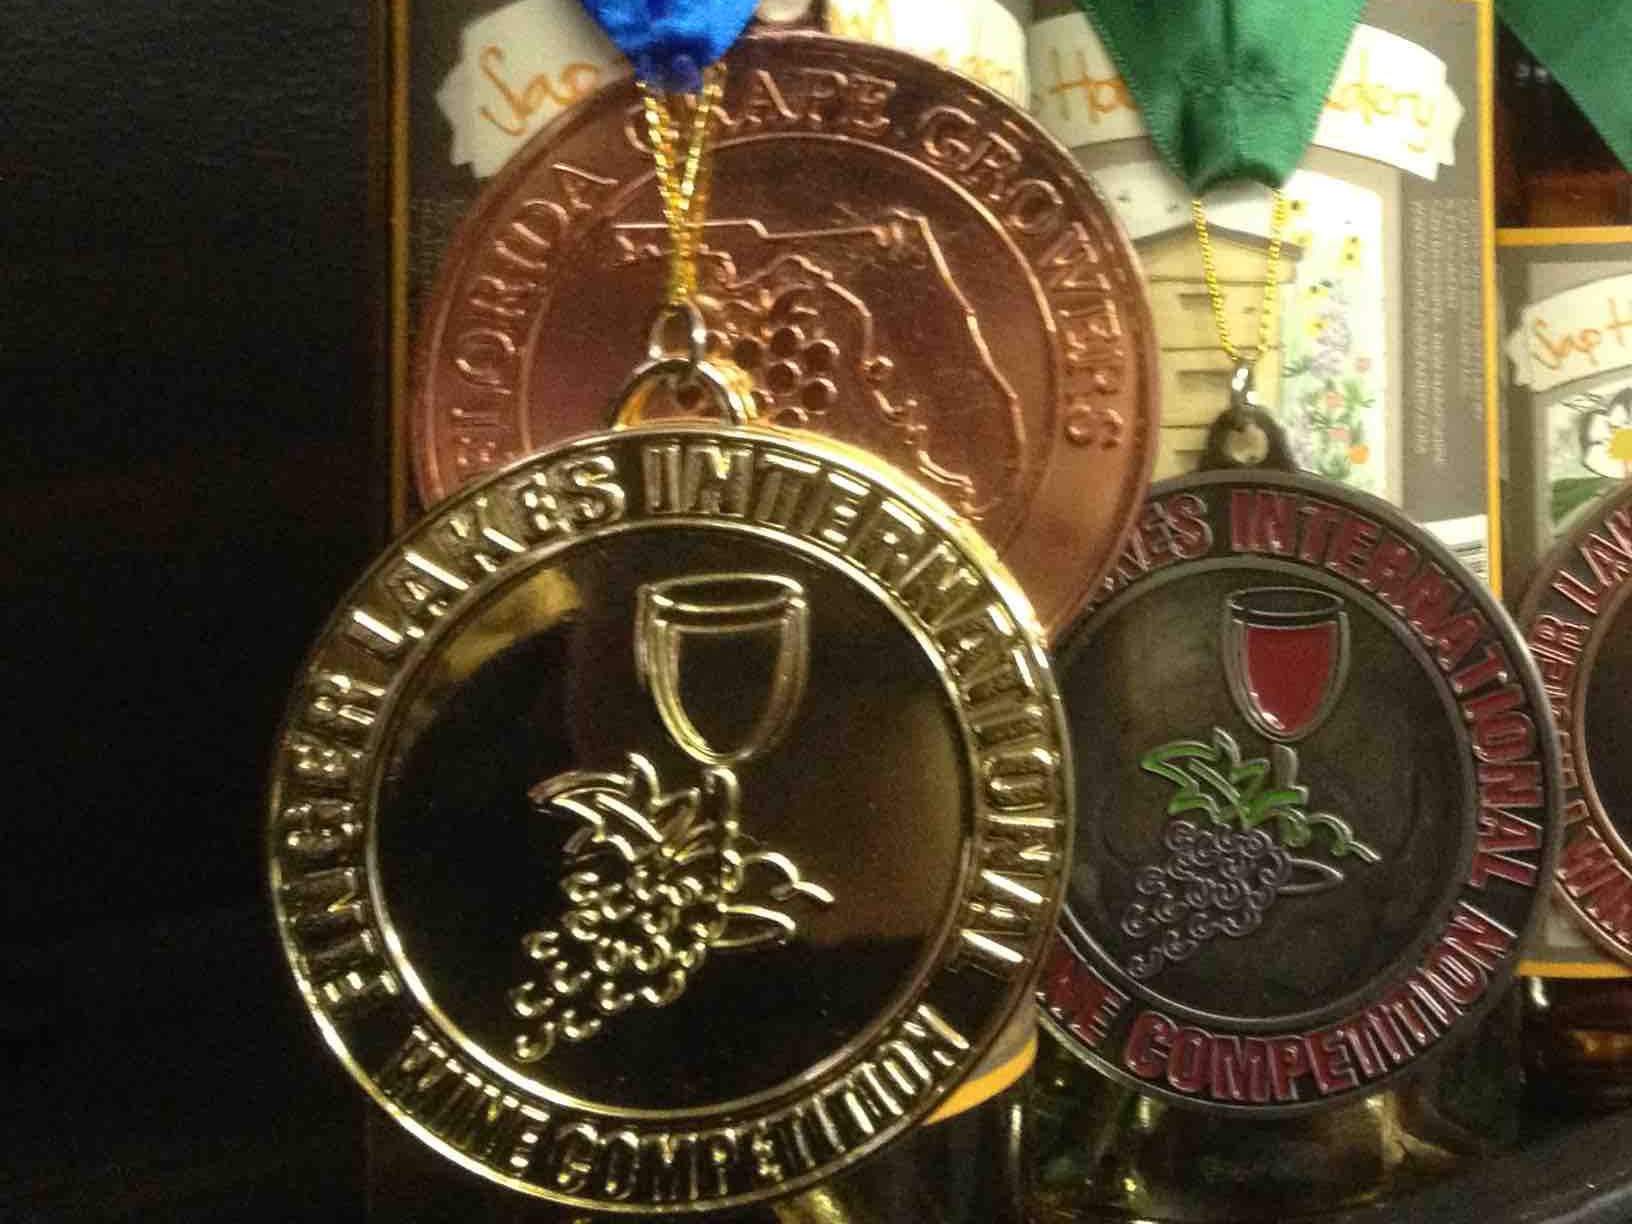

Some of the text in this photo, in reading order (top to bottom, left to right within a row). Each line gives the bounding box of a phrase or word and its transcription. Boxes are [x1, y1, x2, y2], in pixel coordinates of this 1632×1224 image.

[282, 439, 1056, 1006] FINGER LAKES INTERNATIONAL
[1103, 492, 1214, 584] KES
[1230, 488, 1543, 888] INTERNATIONAL
[373, 1002, 971, 1202] WINE COMPETITION
[1122, 898, 1517, 1104] COMPETITION
